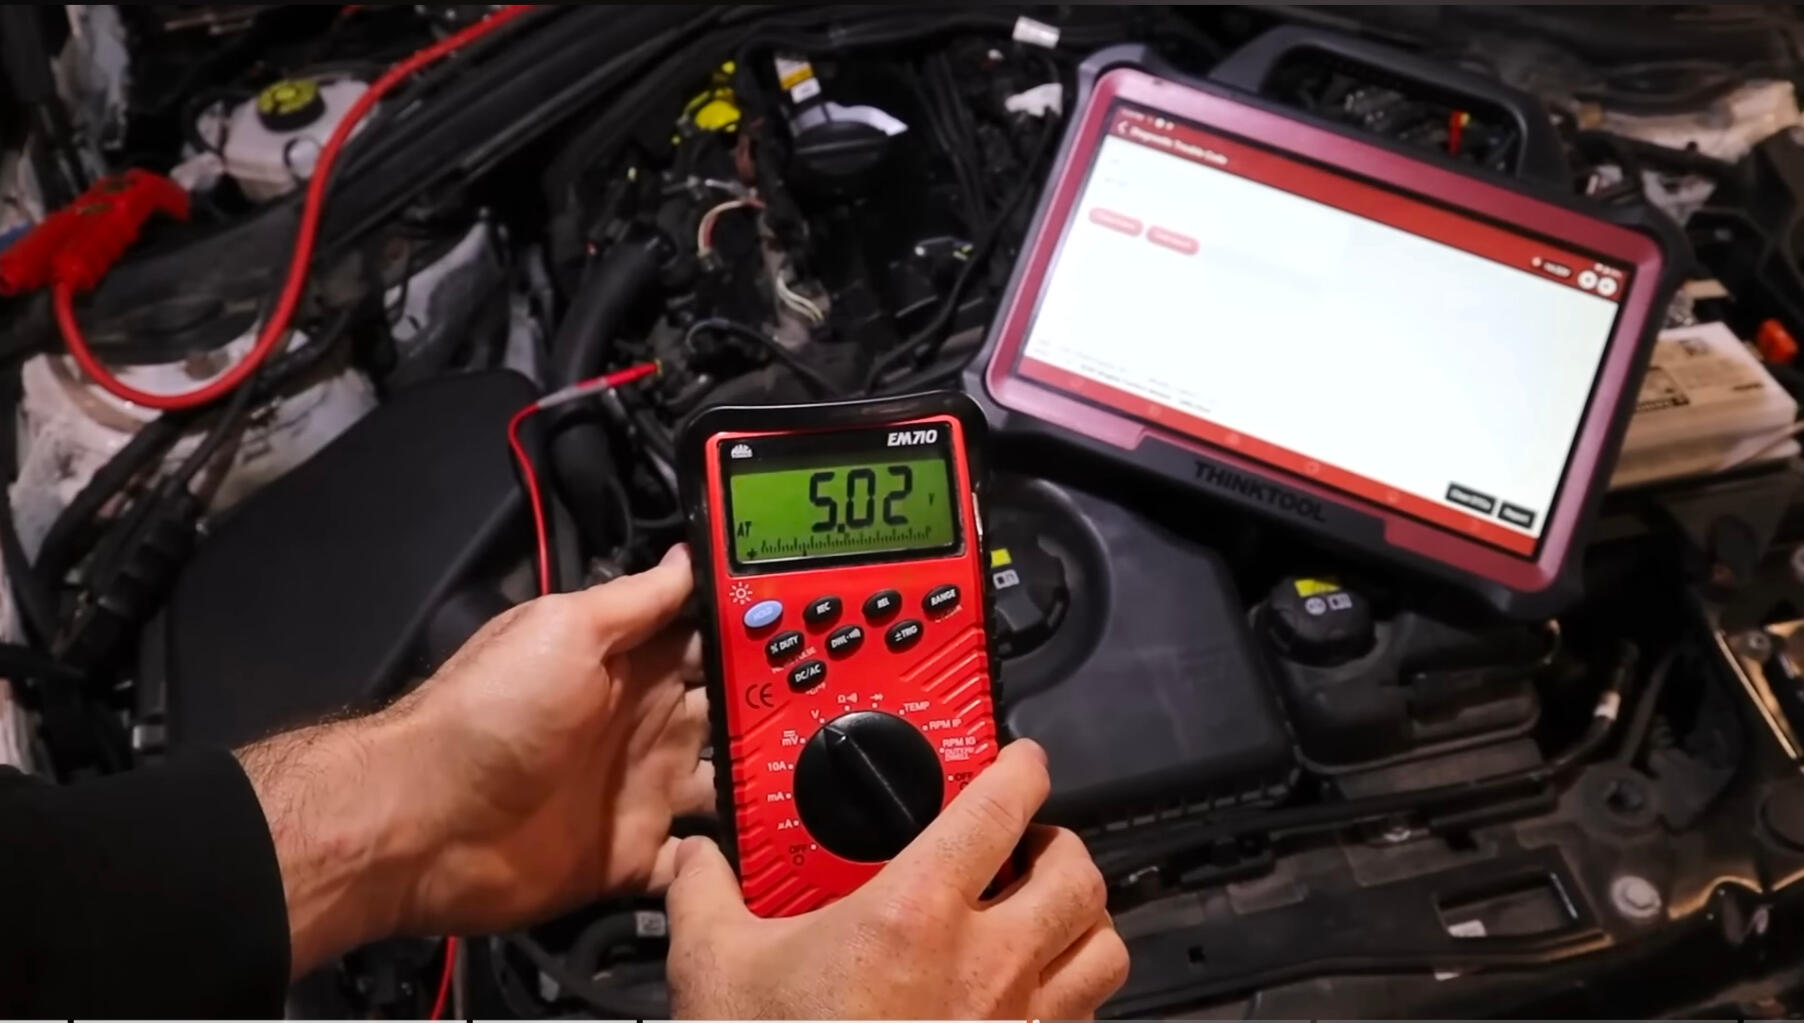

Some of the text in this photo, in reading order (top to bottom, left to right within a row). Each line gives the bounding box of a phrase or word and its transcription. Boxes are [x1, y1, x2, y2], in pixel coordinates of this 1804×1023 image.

[887, 429, 938, 447] EM710
[1192, 459, 1327, 523] THINKTOOL
[809, 465, 913, 533] 5.02
[737, 521, 752, 538] AT
[930, 588, 956, 606] RANGE
[816, 601, 831, 614] REC
[779, 635, 799, 650] DUTY
[795, 664, 821, 682] DC/AC
[745, 683, 775, 709] CE
[904, 701, 930, 712] TEMP
[811, 709, 820, 719] V
[929, 718, 962, 730] RPM IP
[781, 735, 799, 746] mV
[942, 738, 964, 748] RPM
[767, 761, 787, 772] 10A
[767, 792, 785, 803] mA
